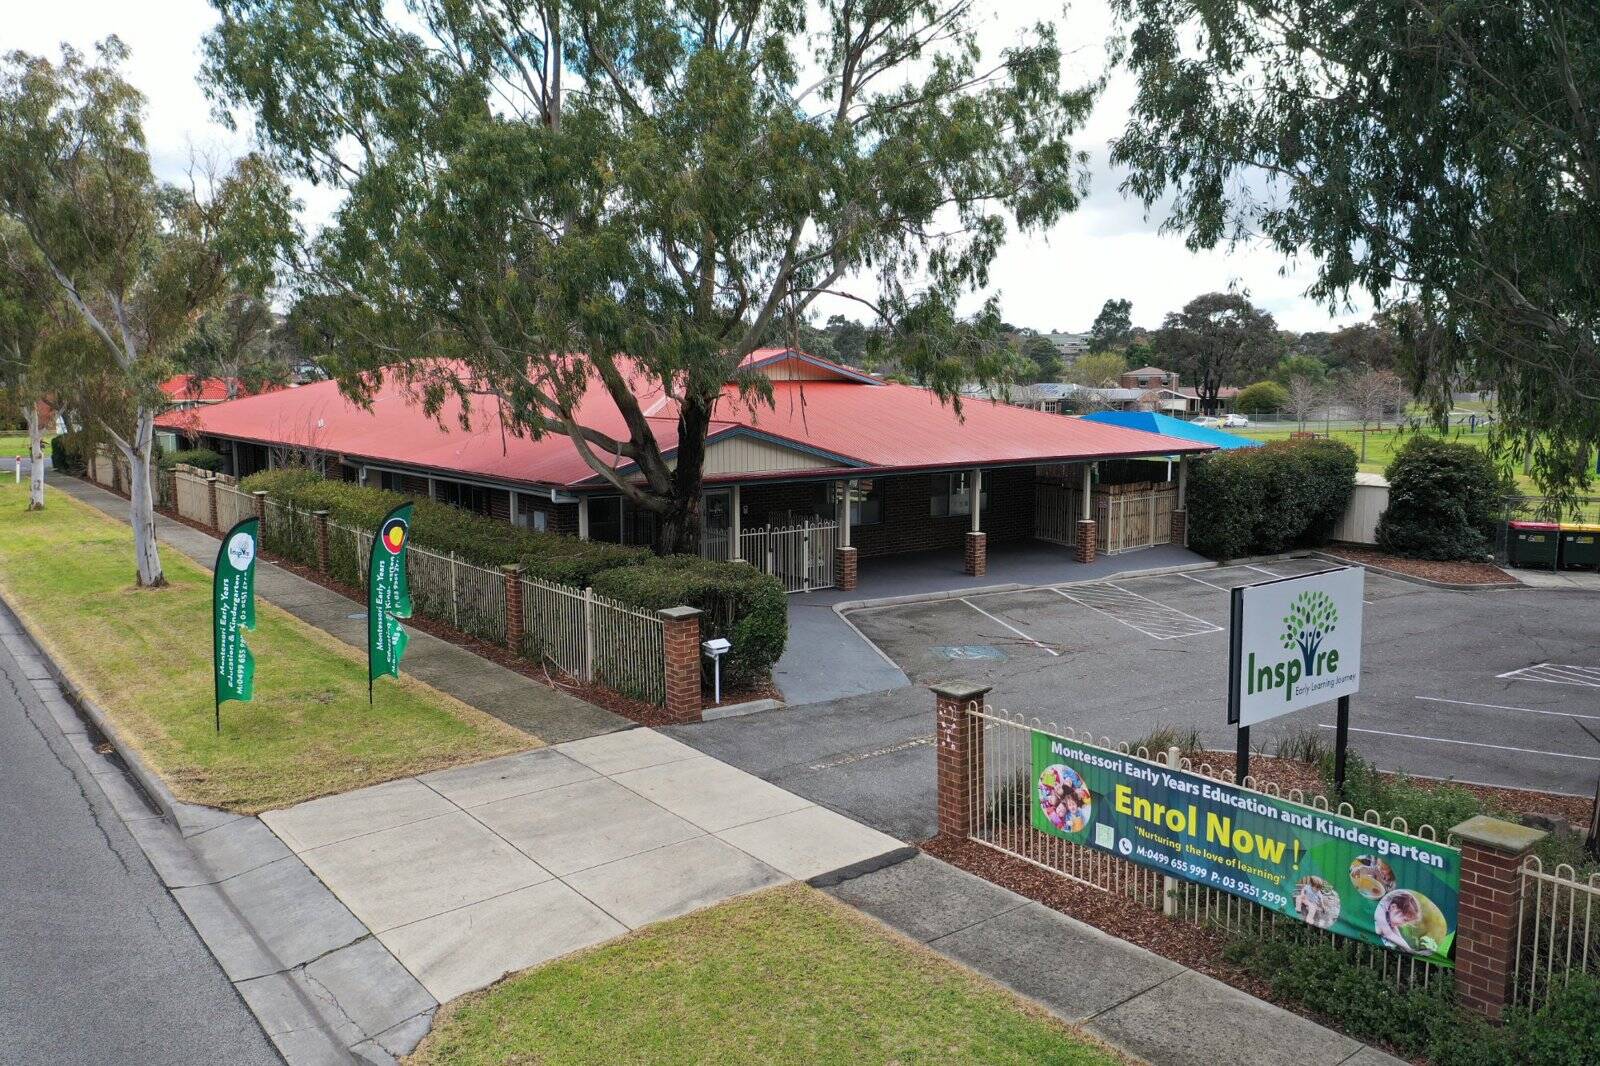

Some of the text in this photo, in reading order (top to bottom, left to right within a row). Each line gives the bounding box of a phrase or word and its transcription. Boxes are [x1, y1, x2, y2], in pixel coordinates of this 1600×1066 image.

[219, 578, 230, 676] Montessori Early Years
[229, 574, 240, 632] Kindergarten
[376, 560, 386, 650] Montessori Early Years
[1296, 672, 1356, 696] Early Learning Journey
[1051, 741, 1444, 868] Montessori Early Years Education and Kindergarten
[1115, 784, 1300, 870] Enrol Now !
[1136, 845, 1288, 906] M:0499 655 999 P: 03 9551 2999
[1185, 844, 1202, 857] the
[1203, 849, 1224, 864] love
[1226, 858, 1237, 868] of
